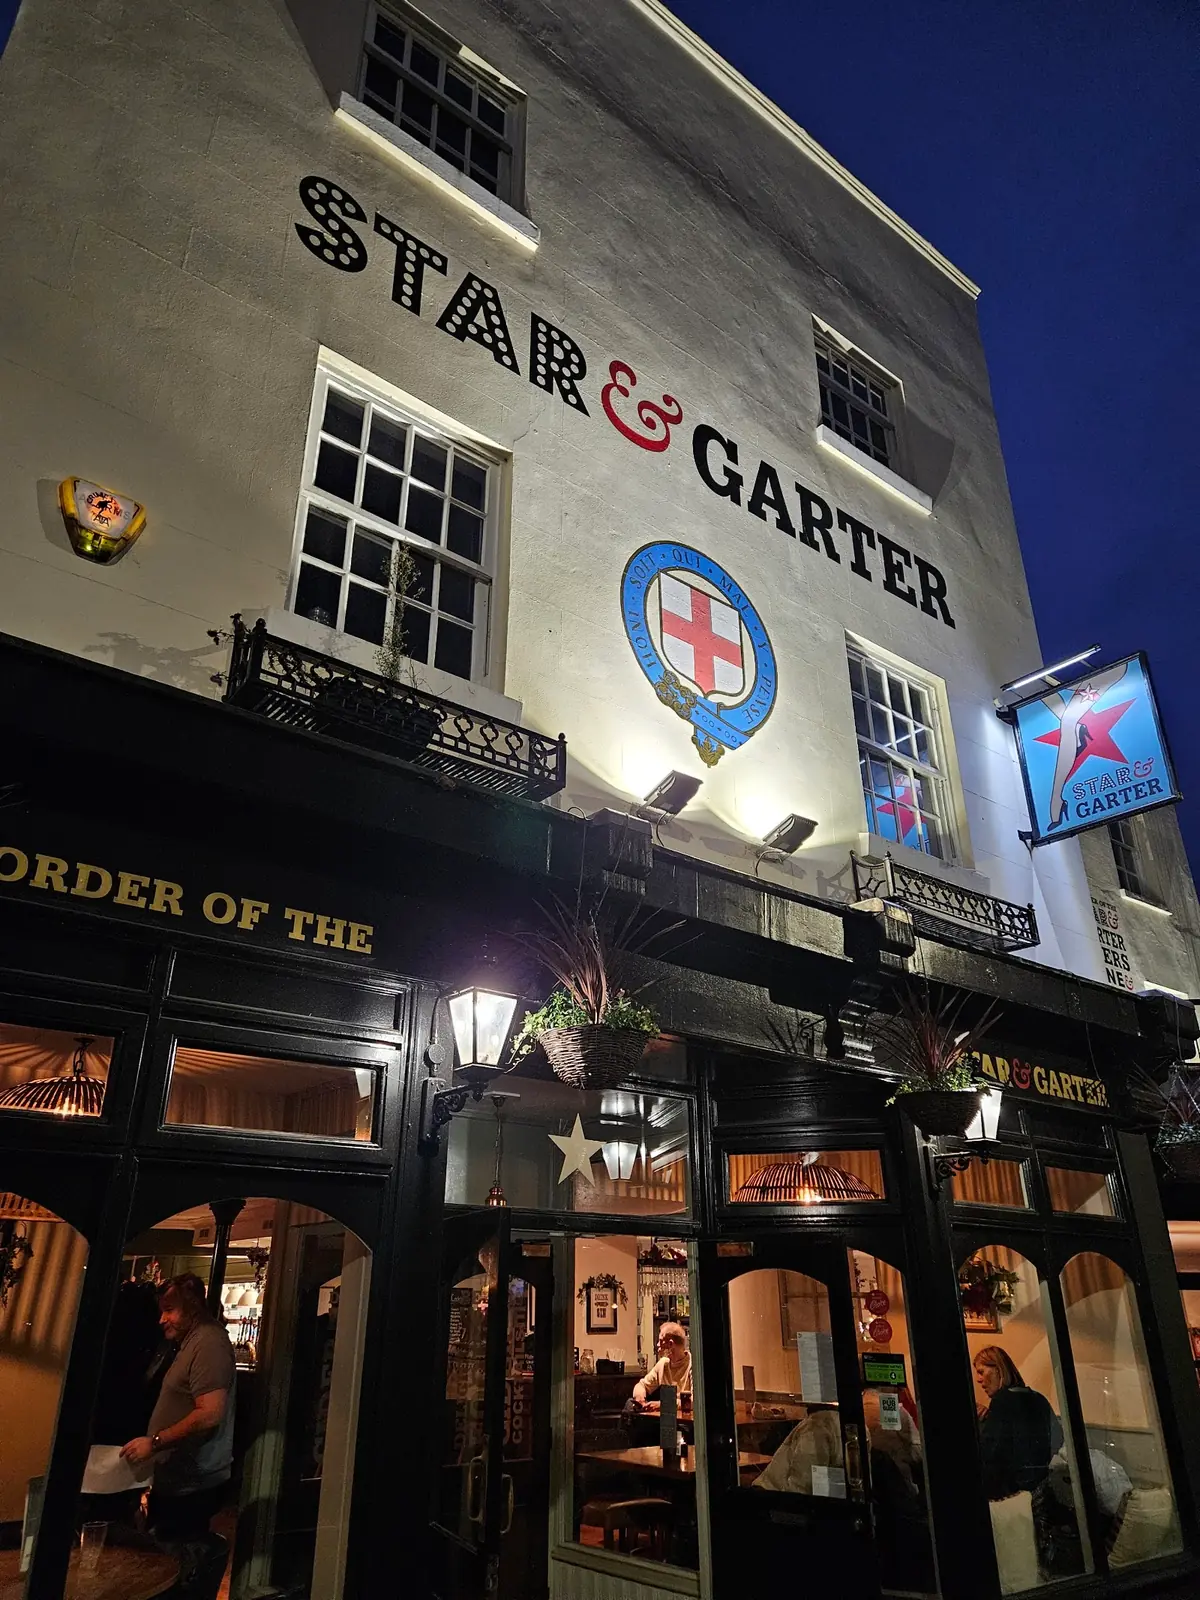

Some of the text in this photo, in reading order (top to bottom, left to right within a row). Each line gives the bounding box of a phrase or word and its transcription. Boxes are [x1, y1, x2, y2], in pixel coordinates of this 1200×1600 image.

[295, 174, 956, 629] STAR & GARTER
[629, 552, 657, 589] SOIT
[671, 548, 702, 568] QUI
[719, 576, 750, 618] MAL
[628, 610, 656, 668] HONI
[742, 675, 772, 724] PENSE
[1072, 757, 1155, 800] STAR &
[1075, 778, 1164, 819] GARTER
[0, 846, 374, 954] ORDER OF THE
[1101, 946, 1130, 971] ERS
[1105, 967, 1126, 988] NE
[1013, 1058, 1031, 1090] &
[1033, 1065, 1110, 1108] GARTER
